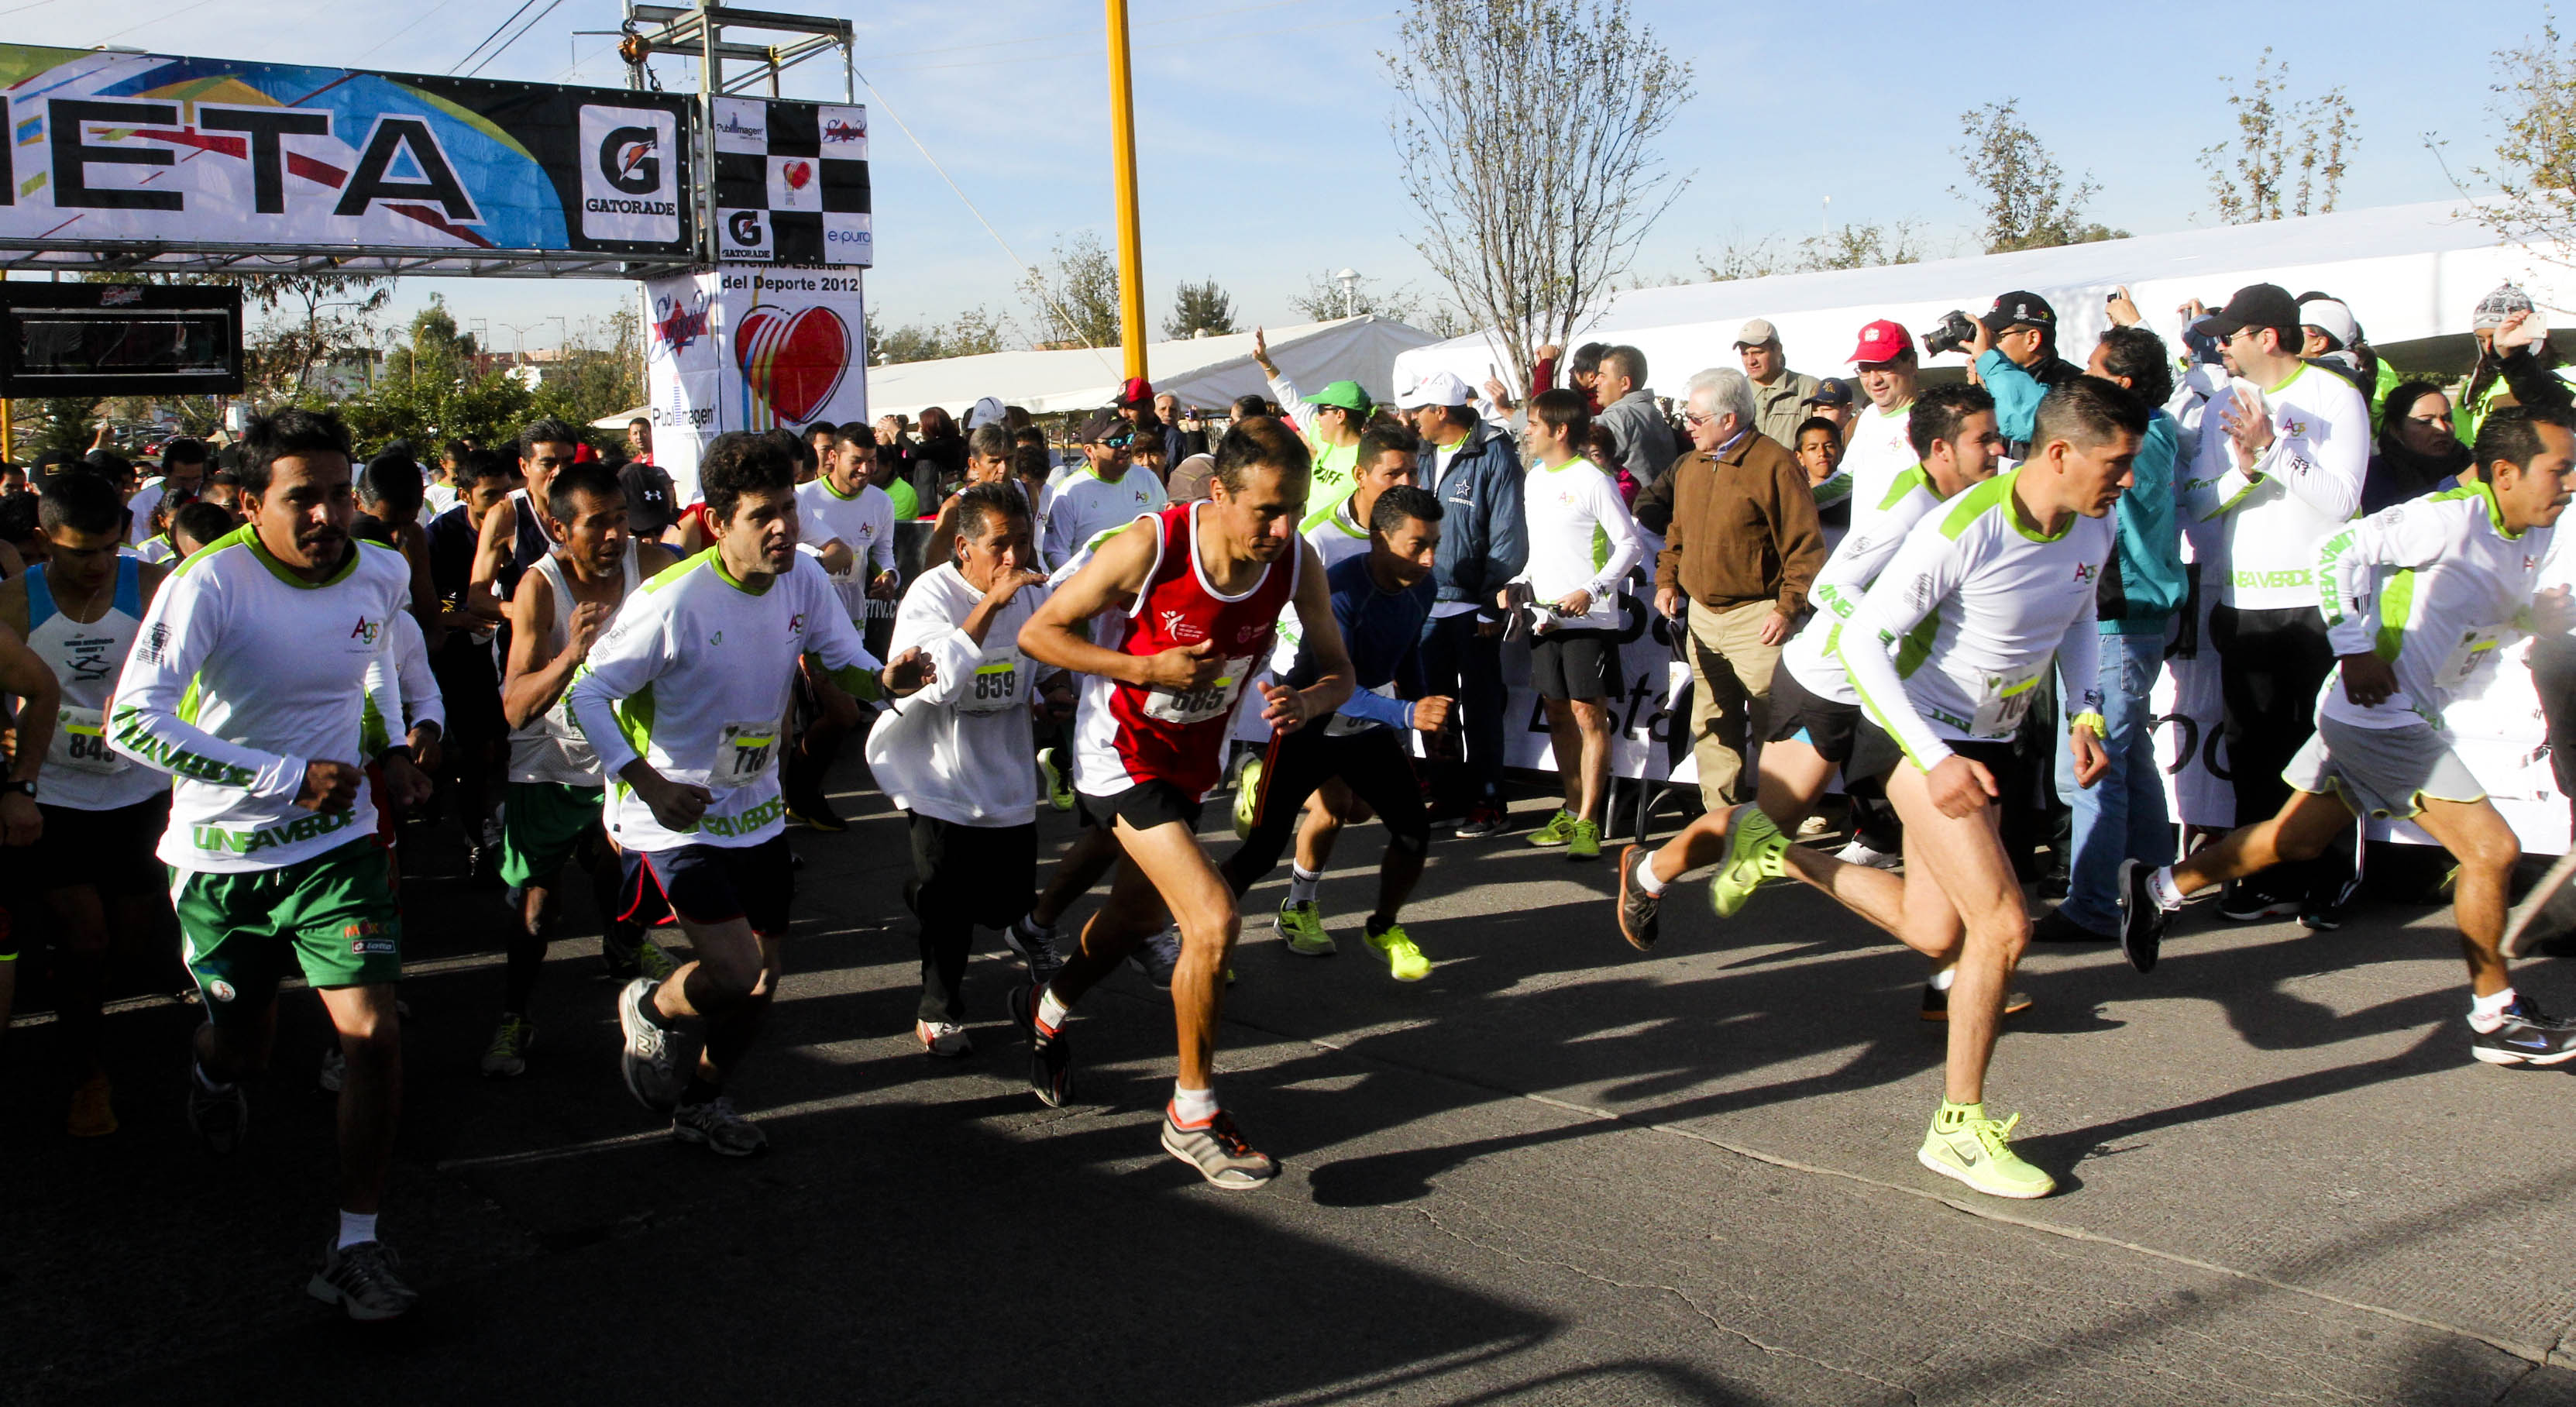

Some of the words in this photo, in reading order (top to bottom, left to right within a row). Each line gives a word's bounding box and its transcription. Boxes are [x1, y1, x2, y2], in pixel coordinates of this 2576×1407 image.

[0, 95, 478, 224] ETA
[586, 198, 676, 216] GATORADE
[722, 249, 770, 258] GATORADE
[722, 275, 748, 290] del
[754, 277, 816, 292] Deporte
[821, 277, 859, 292] 2012
[975, 670, 1016, 700] 859
